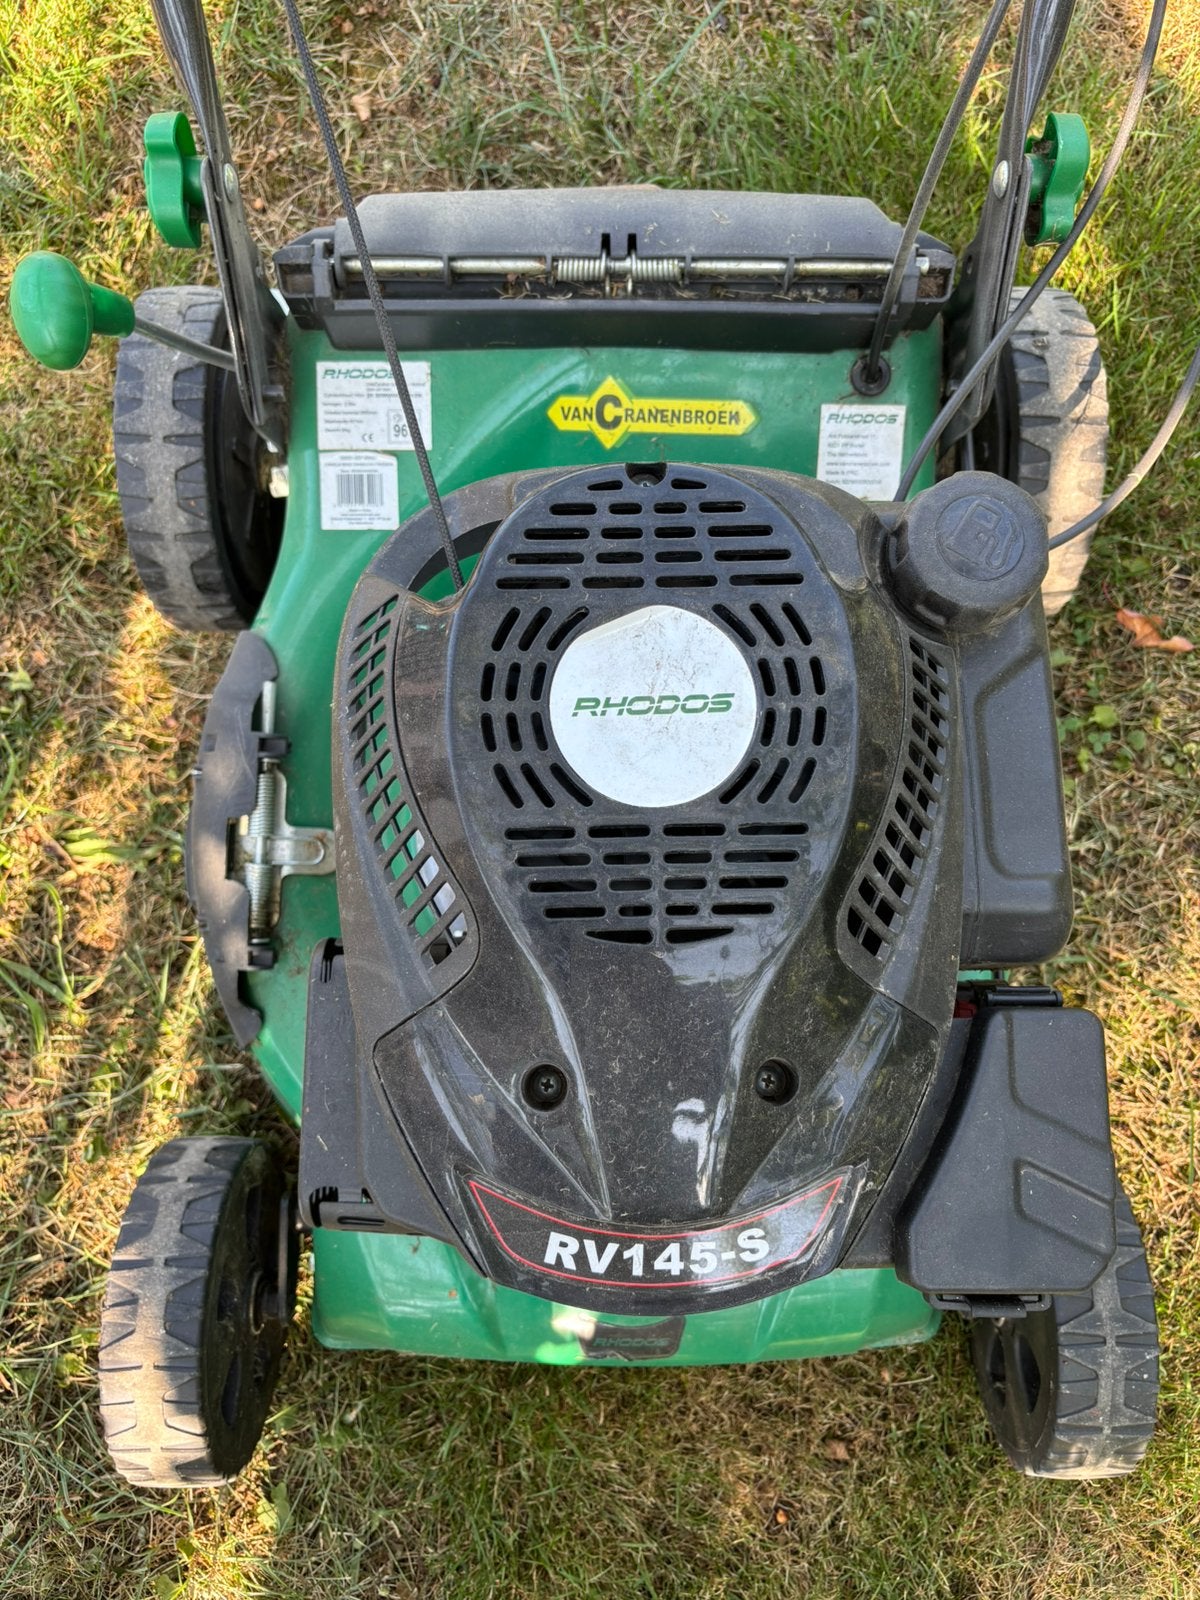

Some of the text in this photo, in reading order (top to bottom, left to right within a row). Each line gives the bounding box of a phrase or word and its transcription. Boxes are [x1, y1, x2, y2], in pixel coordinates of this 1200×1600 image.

[560, 394, 741, 430] VAN CRANENBROEK
[826, 413, 899, 424] RHODOS
[393, 424, 408, 437] 96
[571, 692, 736, 717] RHODOS
[543, 1227, 770, 1277] RV145-S
[593, 1337, 671, 1347] RHODOS
